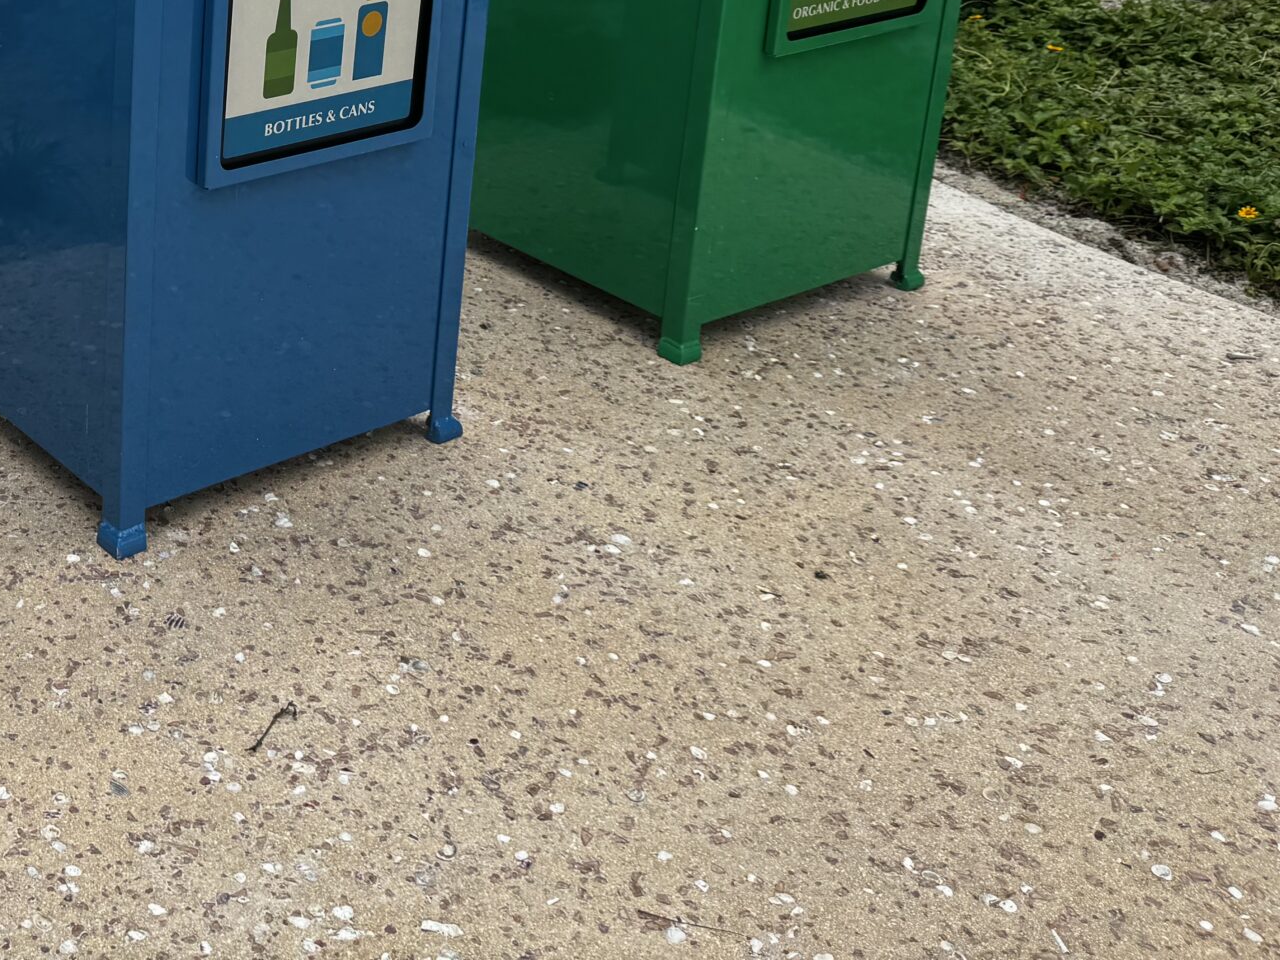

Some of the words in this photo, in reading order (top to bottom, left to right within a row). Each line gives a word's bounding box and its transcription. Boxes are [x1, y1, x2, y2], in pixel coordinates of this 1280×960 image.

[792, 0, 841, 20] ORGANIC
[264, 112, 323, 137] BOTTLES
[326, 110, 336, 122] &
[339, 100, 376, 121] CANS
